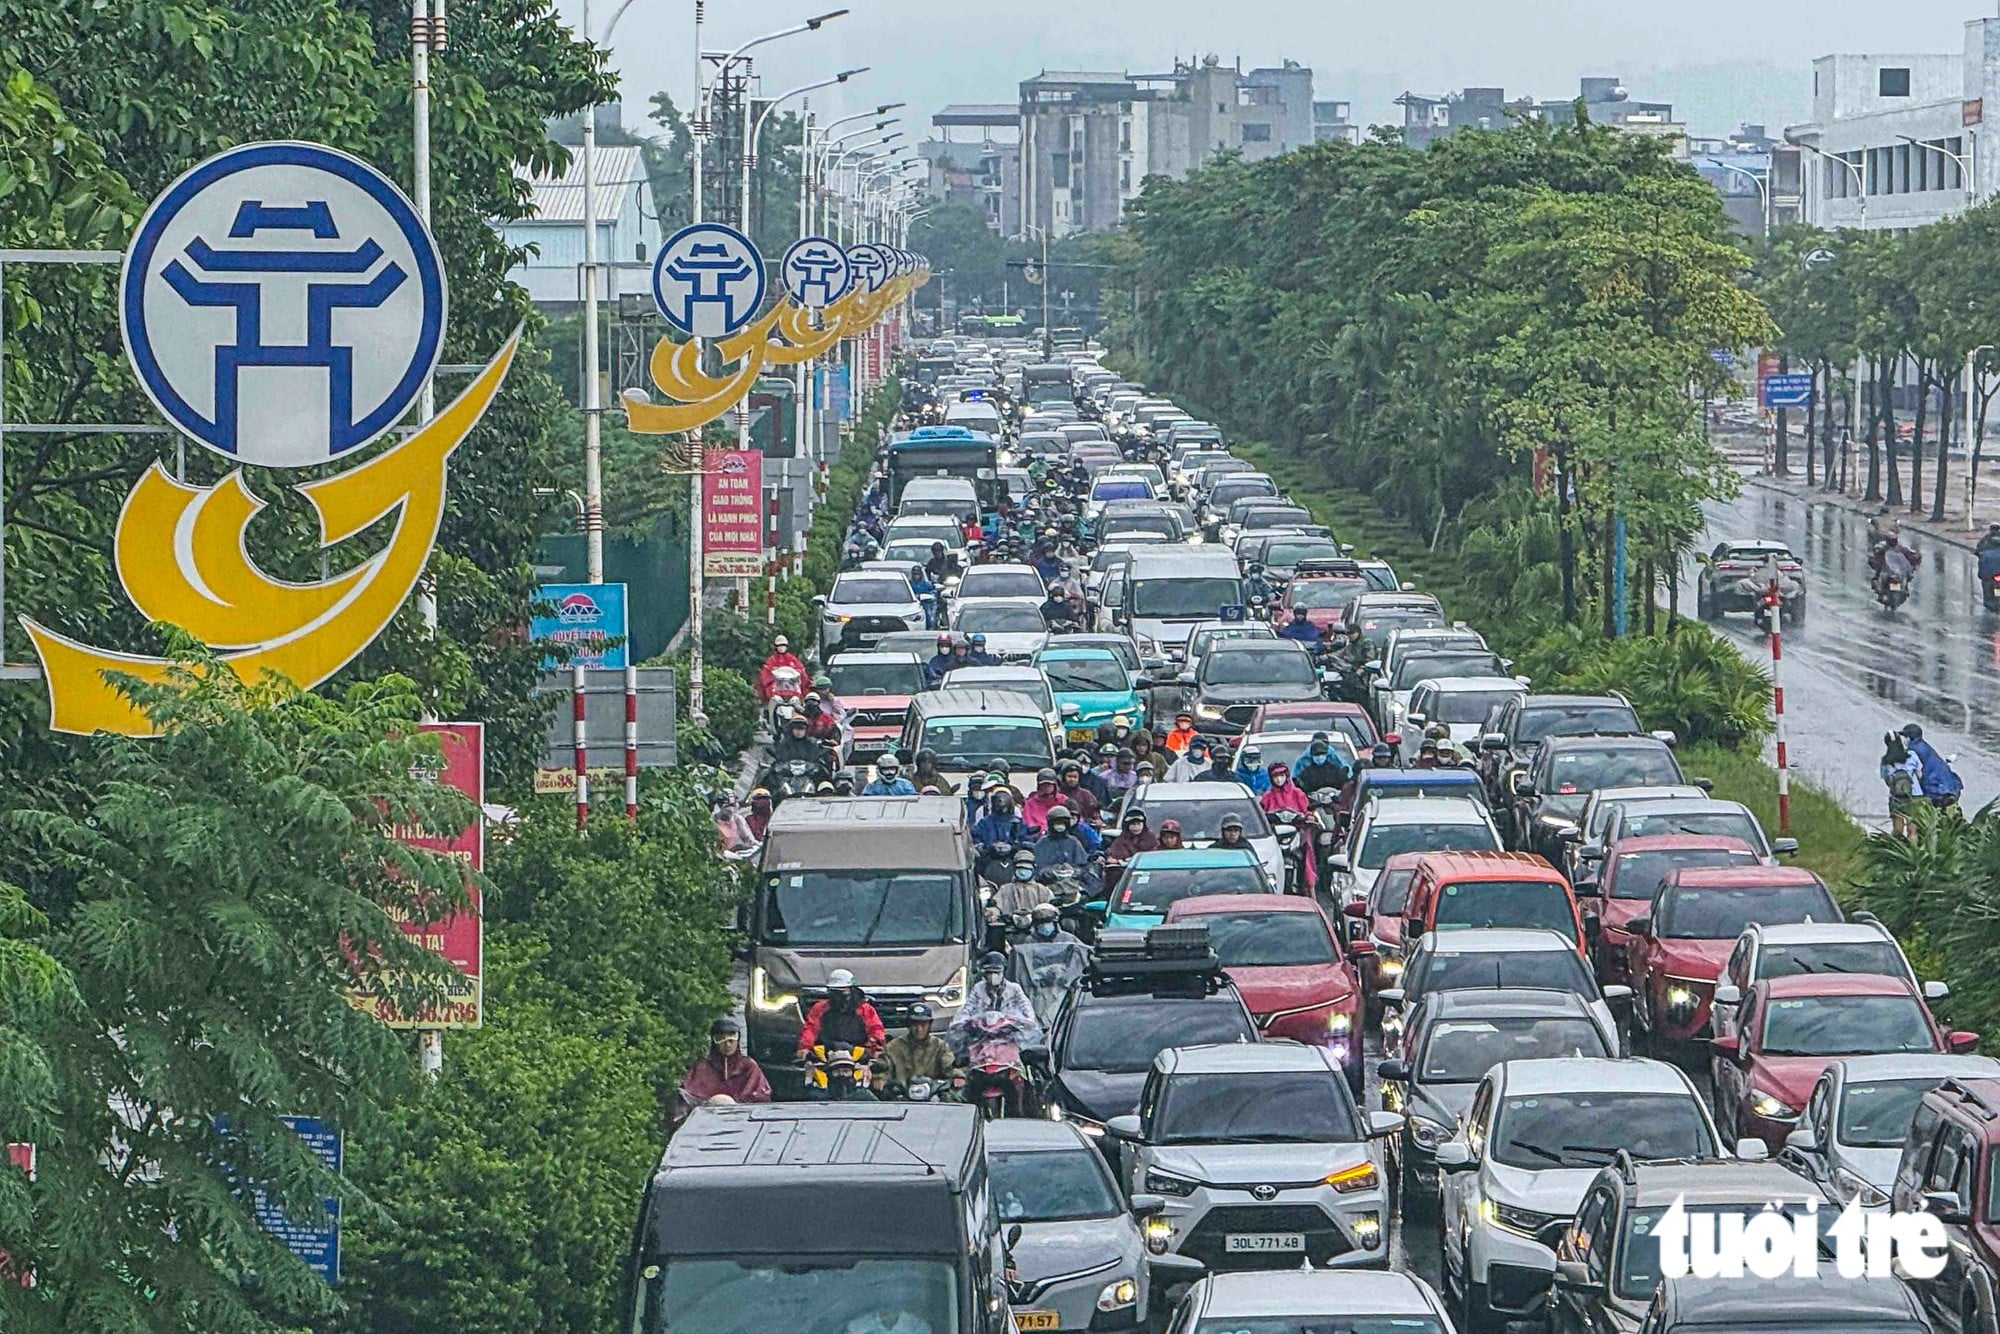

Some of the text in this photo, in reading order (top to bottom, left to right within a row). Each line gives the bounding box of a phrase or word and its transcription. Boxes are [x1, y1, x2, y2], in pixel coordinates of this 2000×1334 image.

[718, 476, 749, 489] AN TOÀN
[712, 495, 729, 506] GIAO
[708, 511, 717, 523] LÀ
[425, 933, 445, 951] TA!
